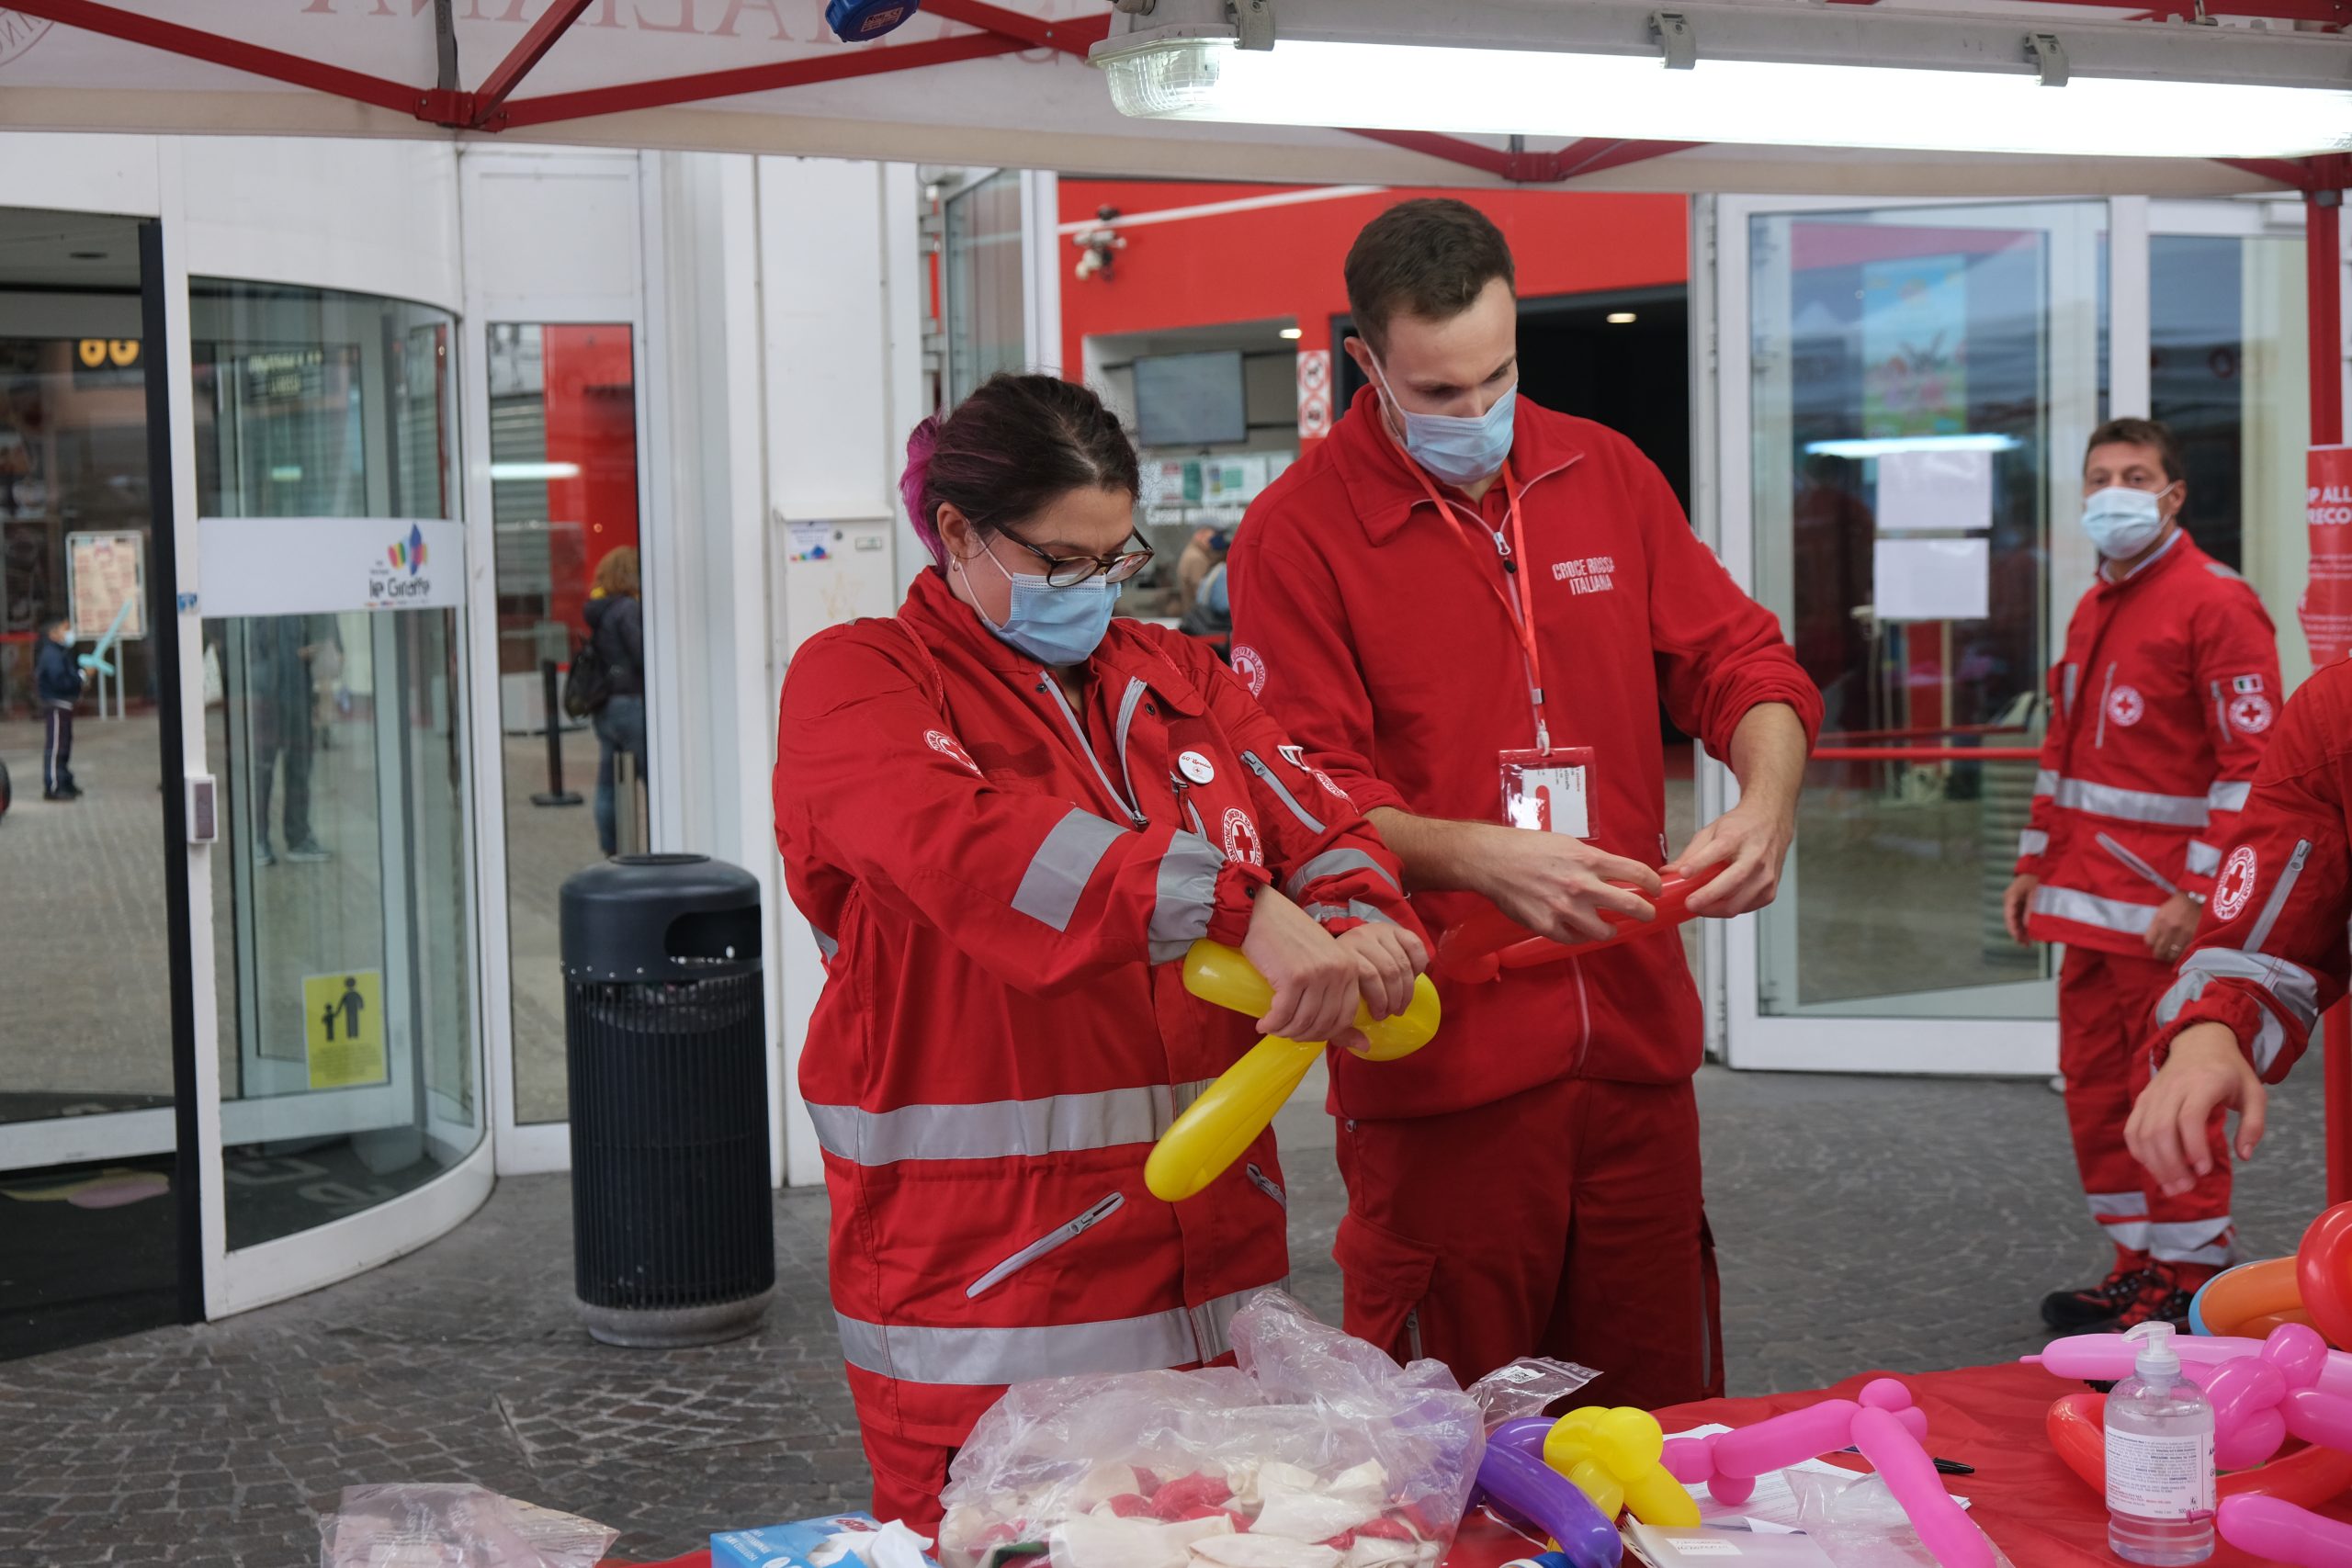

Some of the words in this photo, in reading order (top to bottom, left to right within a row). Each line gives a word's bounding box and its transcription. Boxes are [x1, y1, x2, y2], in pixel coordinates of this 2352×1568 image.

[1552, 559, 1588, 581] CROCE
[1587, 557, 1615, 575] ROSSA
[1569, 574, 1614, 595] ITALIANA
